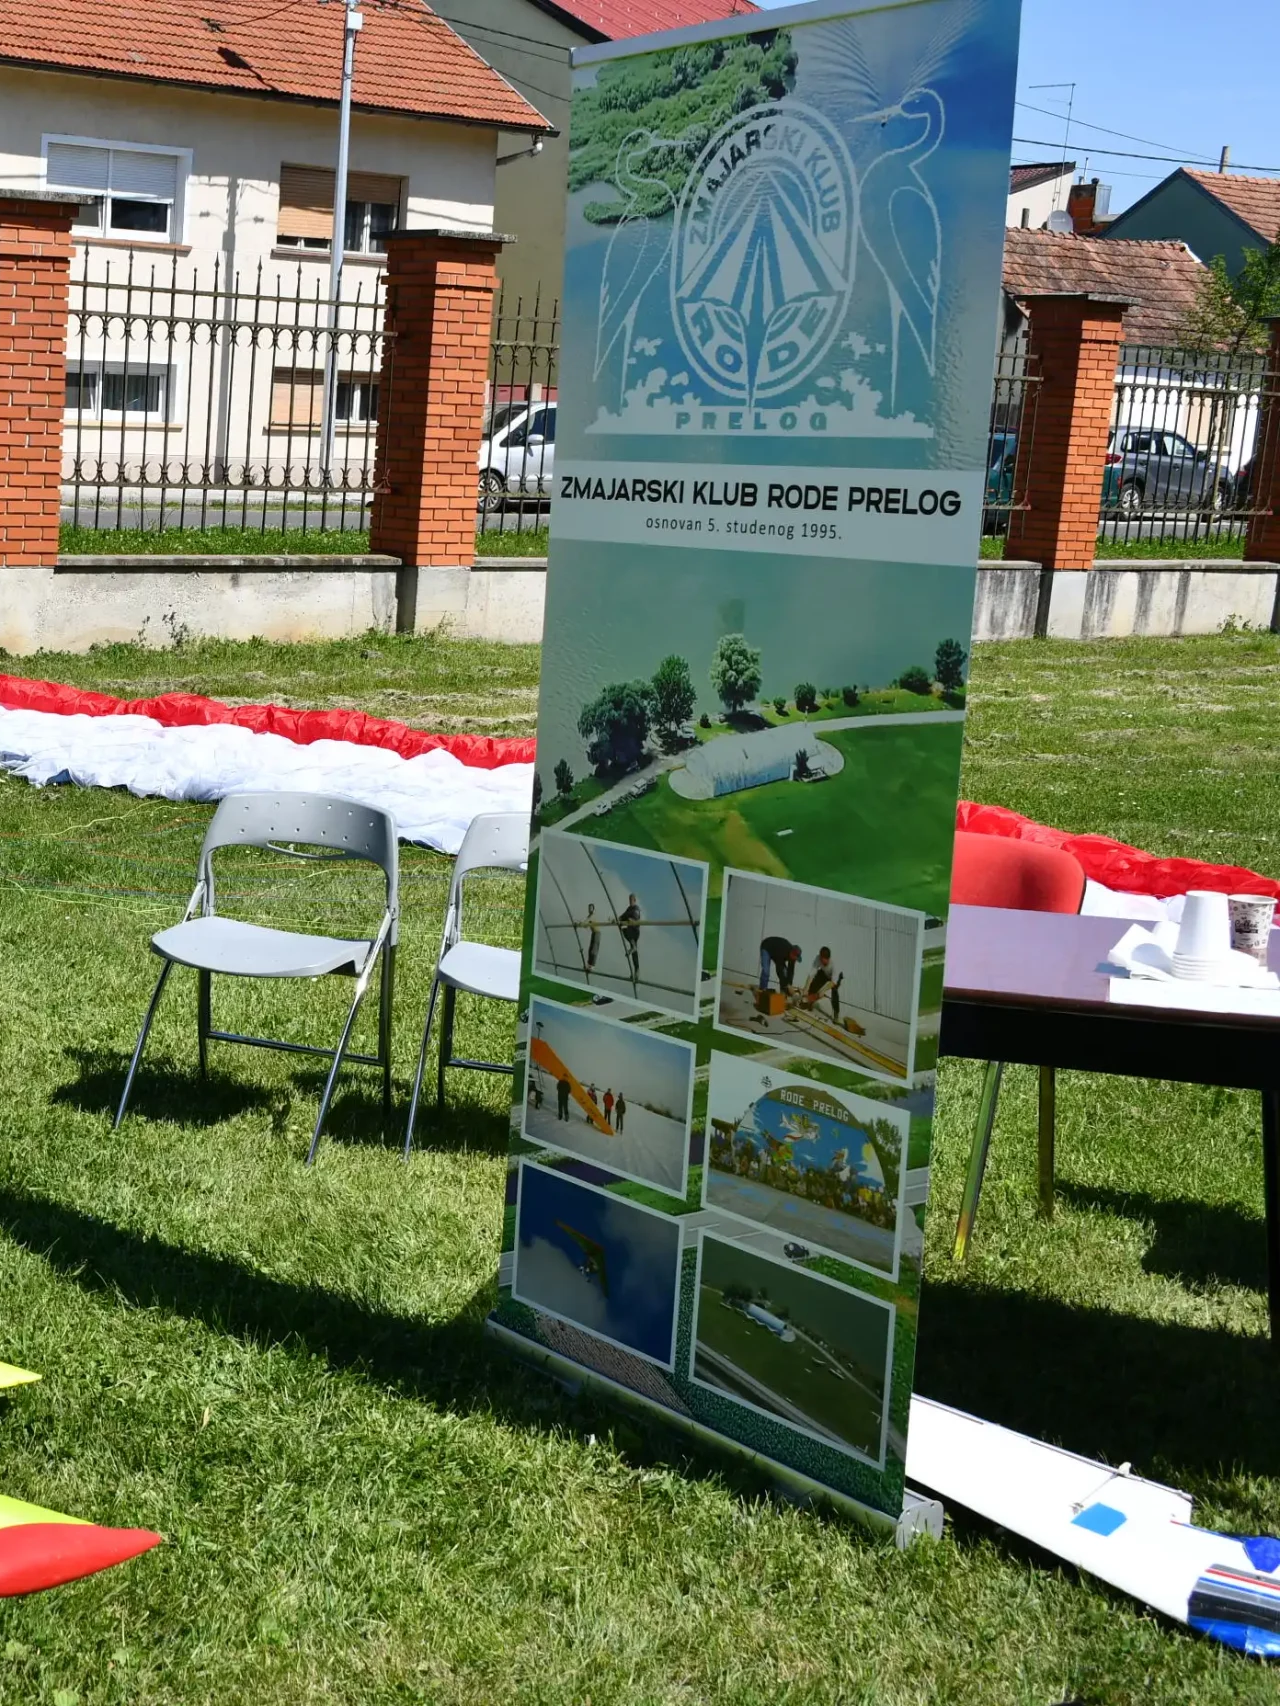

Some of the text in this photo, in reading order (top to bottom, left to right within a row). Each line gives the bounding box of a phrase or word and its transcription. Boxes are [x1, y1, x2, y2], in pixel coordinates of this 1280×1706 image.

[689, 123, 841, 245] ZMAJARSKI KLUB
[690, 299, 828, 374] RODE
[675, 411, 827, 431] PRELOG
[561, 475, 962, 517] ZMAJARSKI KLUB RODE PRELOG
[646, 515, 843, 541] osnovan 5. studenog 1995.
[780, 1088, 850, 1122] RODE PRELOG
